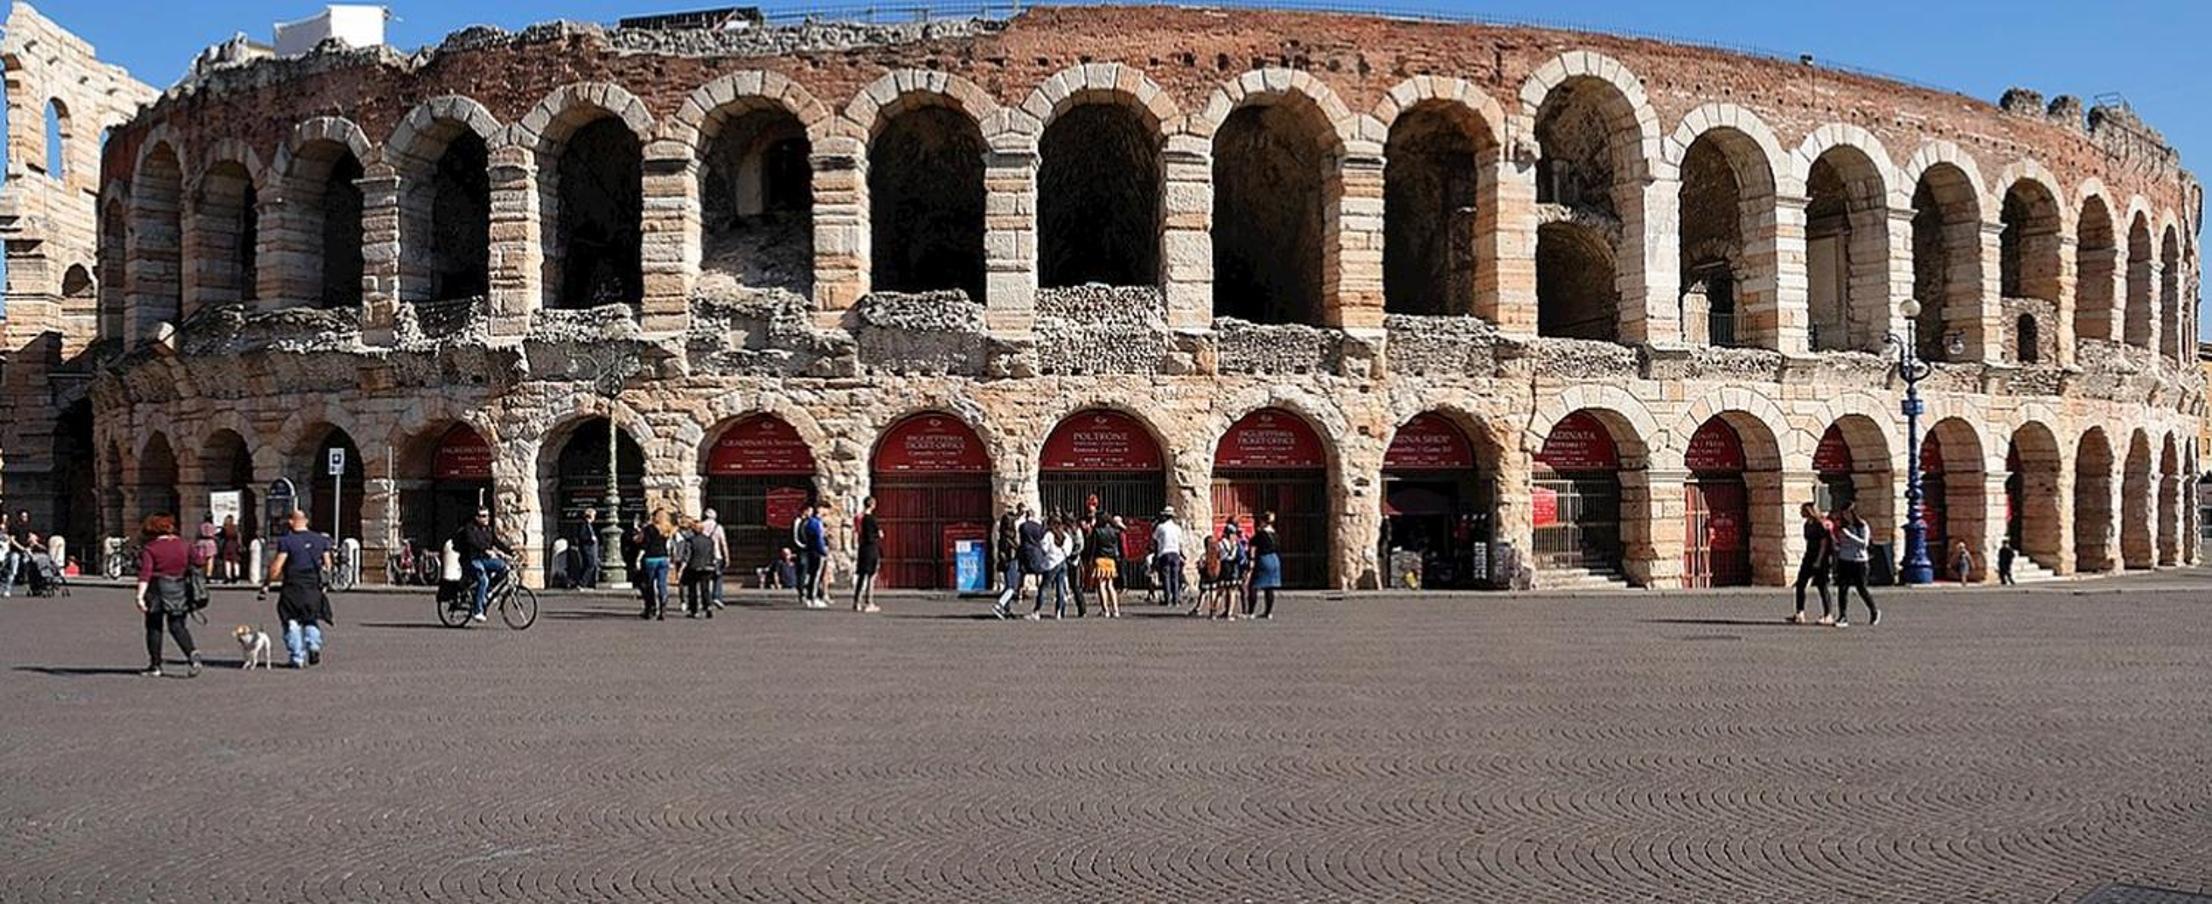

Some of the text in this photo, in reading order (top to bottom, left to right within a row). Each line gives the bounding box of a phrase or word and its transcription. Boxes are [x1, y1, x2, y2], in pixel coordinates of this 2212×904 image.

[1073, 432, 1128, 441] POLTRONE
[1551, 431, 1598, 440] ADINATA
[904, 441, 966, 449] TICKET OFFICE
